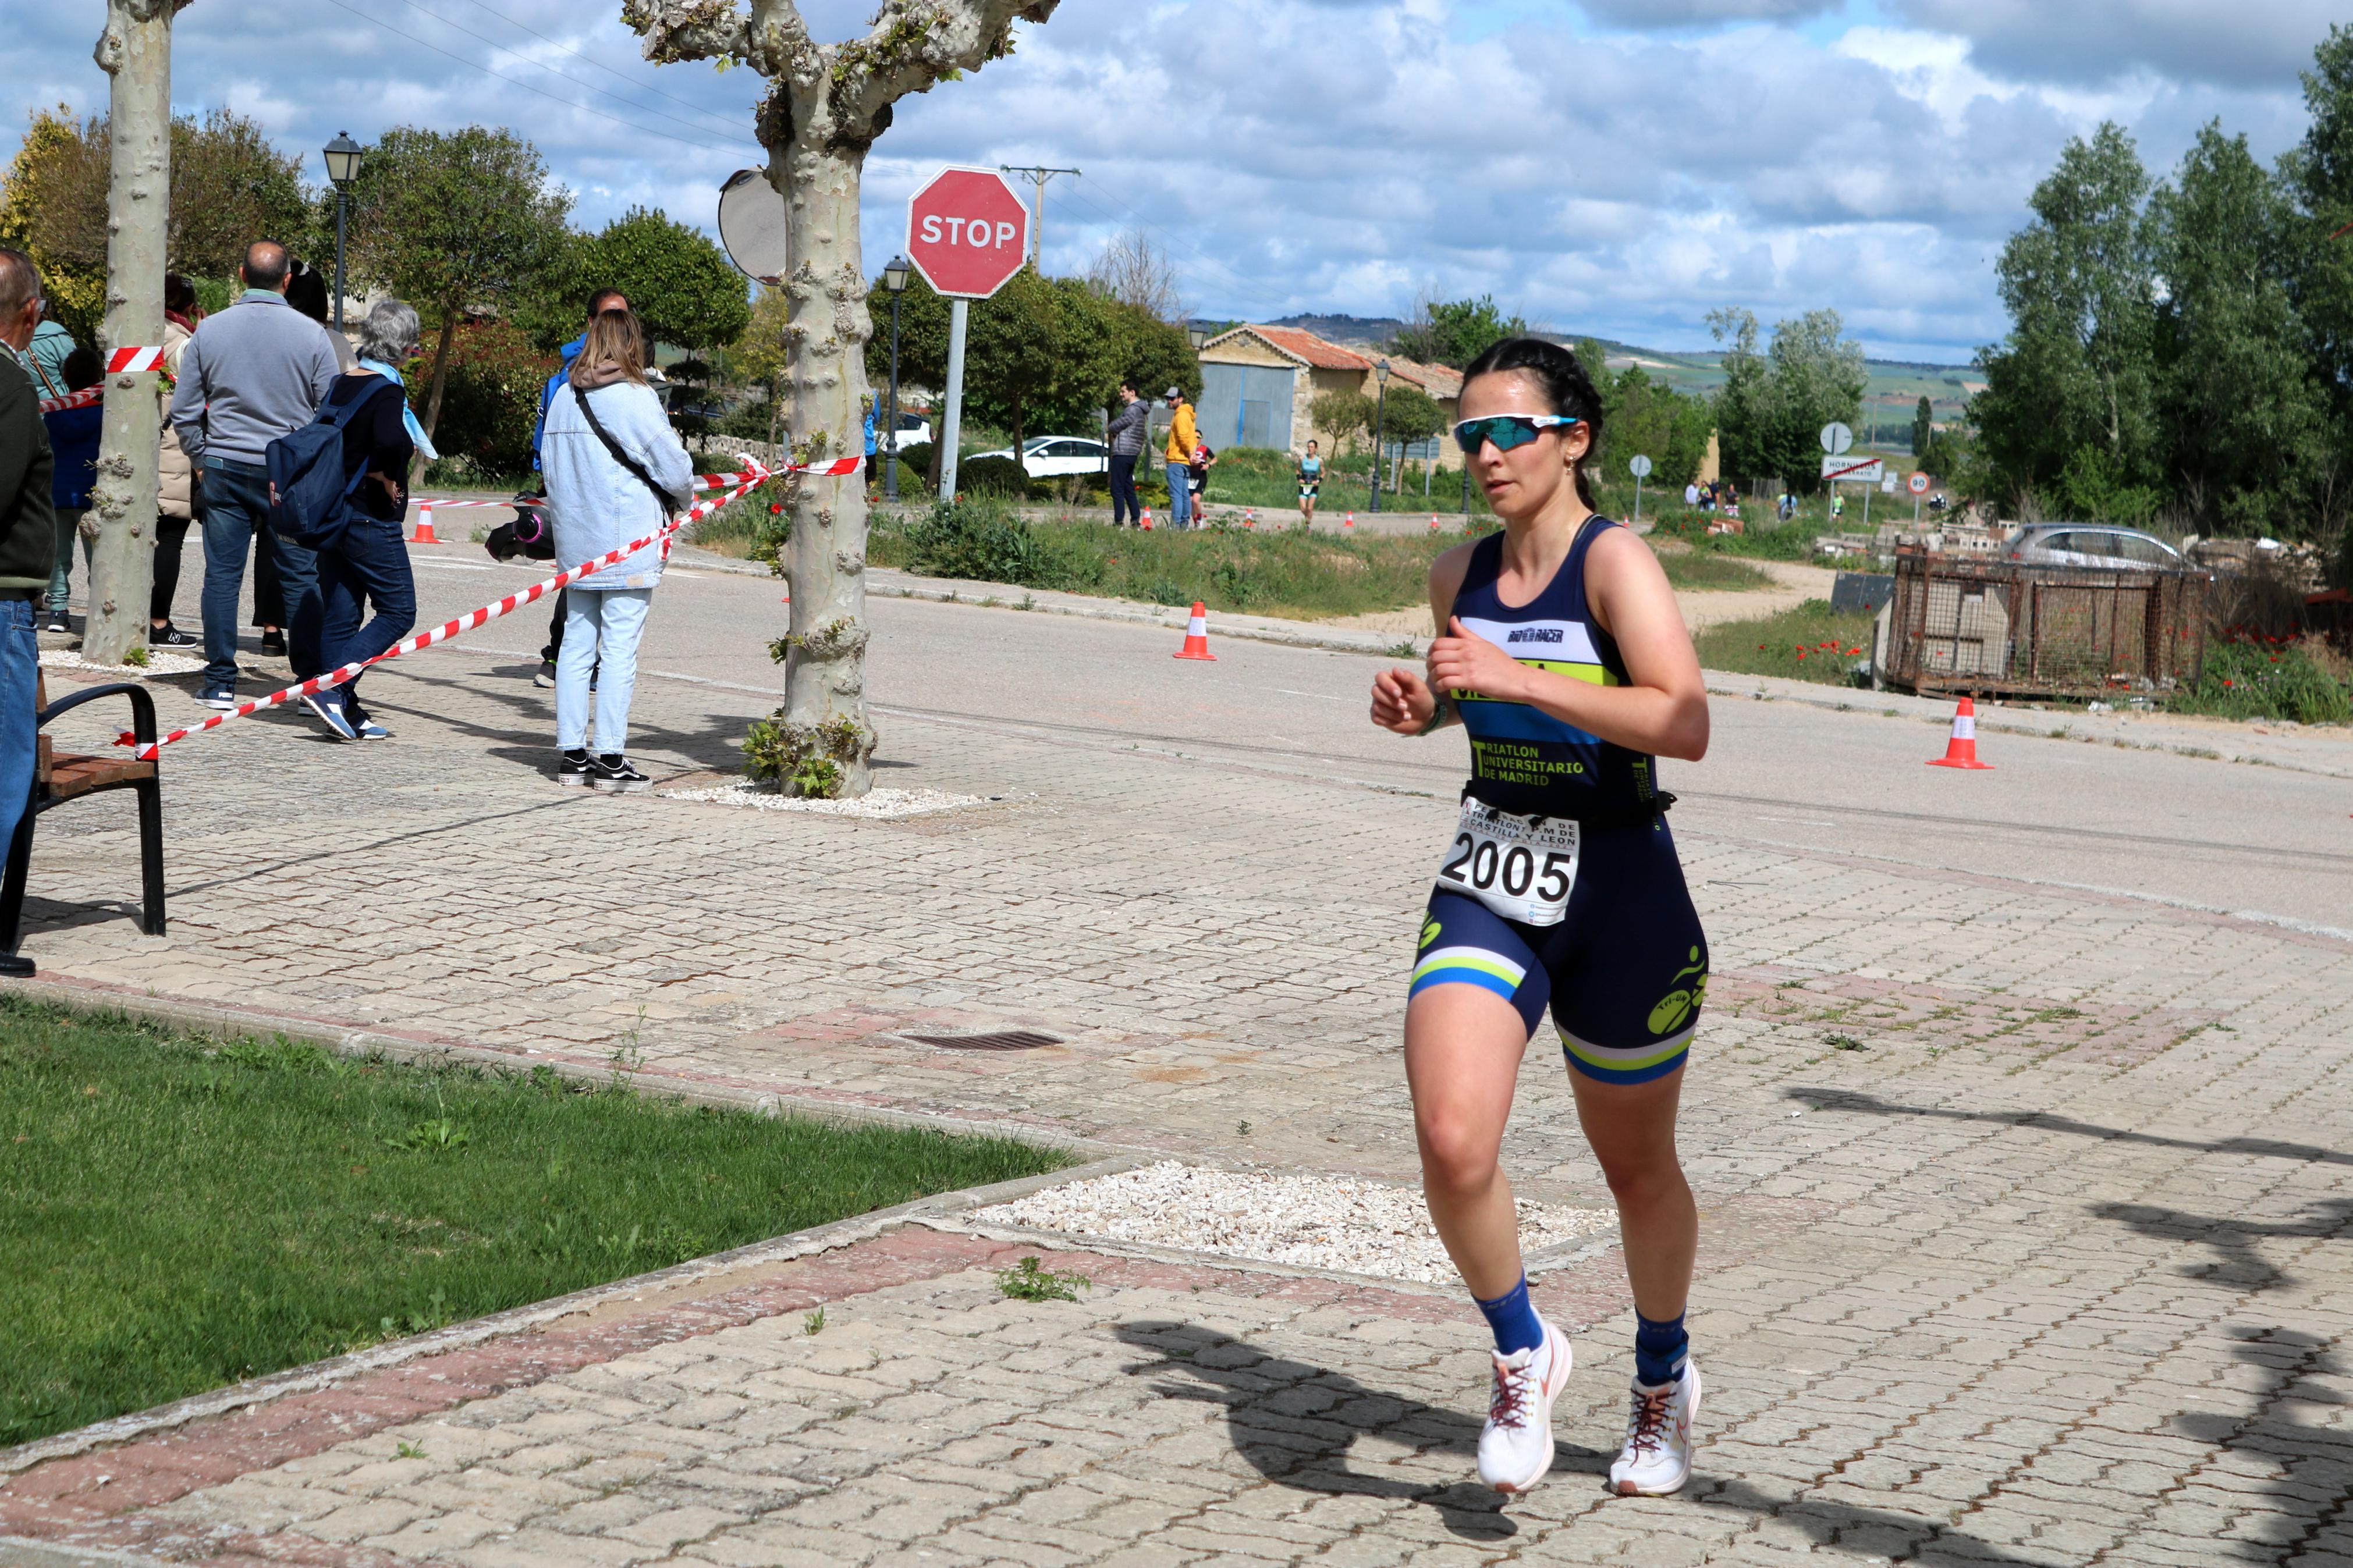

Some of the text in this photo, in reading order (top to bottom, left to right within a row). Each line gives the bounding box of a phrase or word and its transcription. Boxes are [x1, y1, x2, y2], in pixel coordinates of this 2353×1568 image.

[920, 215, 1016, 249] STOP
[1485, 755, 1584, 773] UNIVERSITARIO
[1485, 769, 1549, 785] DE MADRID
[1541, 835, 1575, 845] LEON
[1560, 830, 1575, 838] DE
[1440, 832, 1571, 902] 2005
